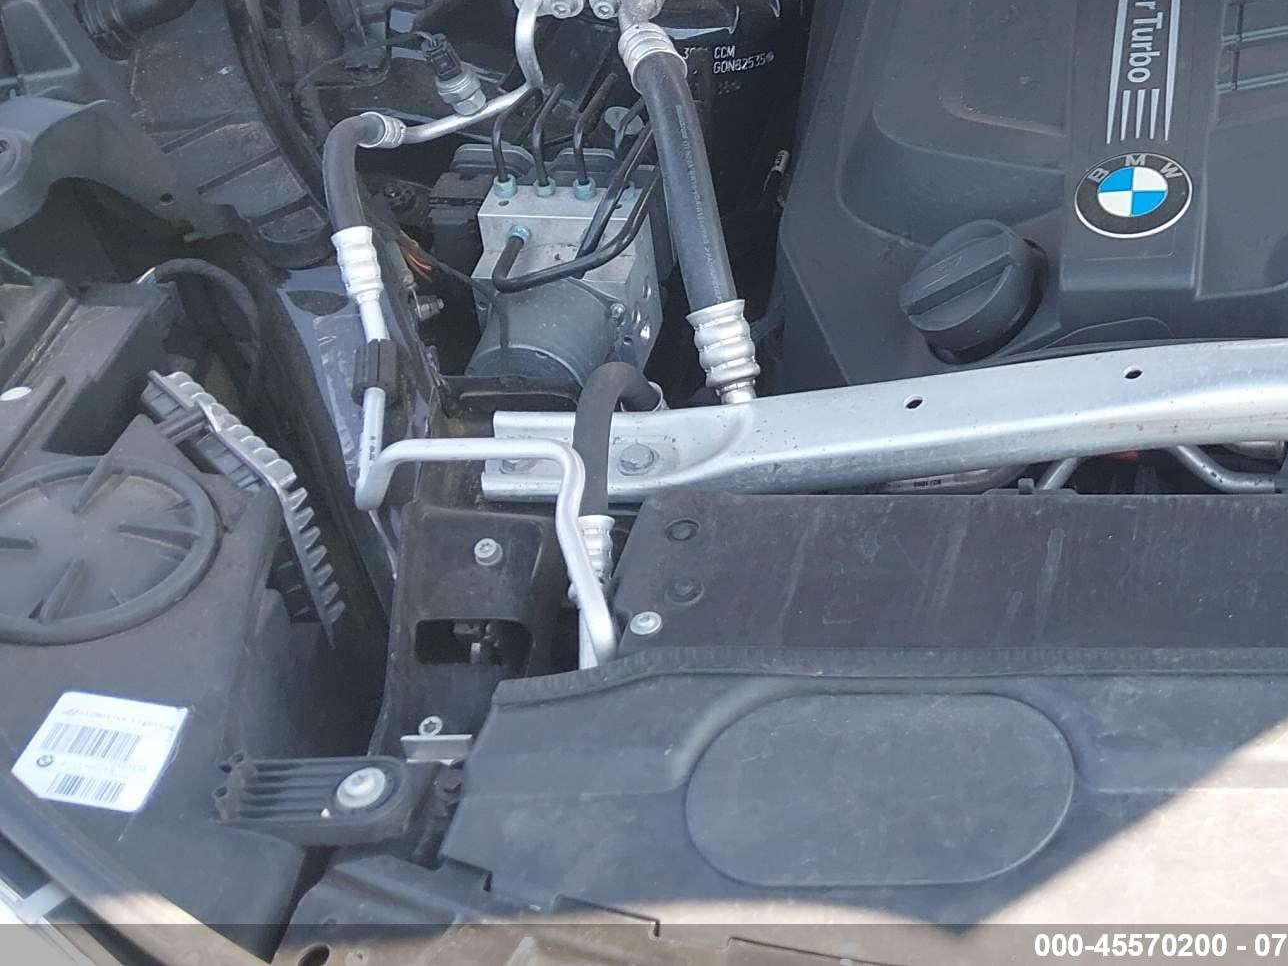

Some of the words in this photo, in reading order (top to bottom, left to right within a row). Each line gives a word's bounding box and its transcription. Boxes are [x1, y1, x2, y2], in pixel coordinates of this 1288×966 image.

[713, 45, 736, 60] CCM
[1127, 11, 1164, 84] Turbo
[1087, 153, 1183, 183] BMW
